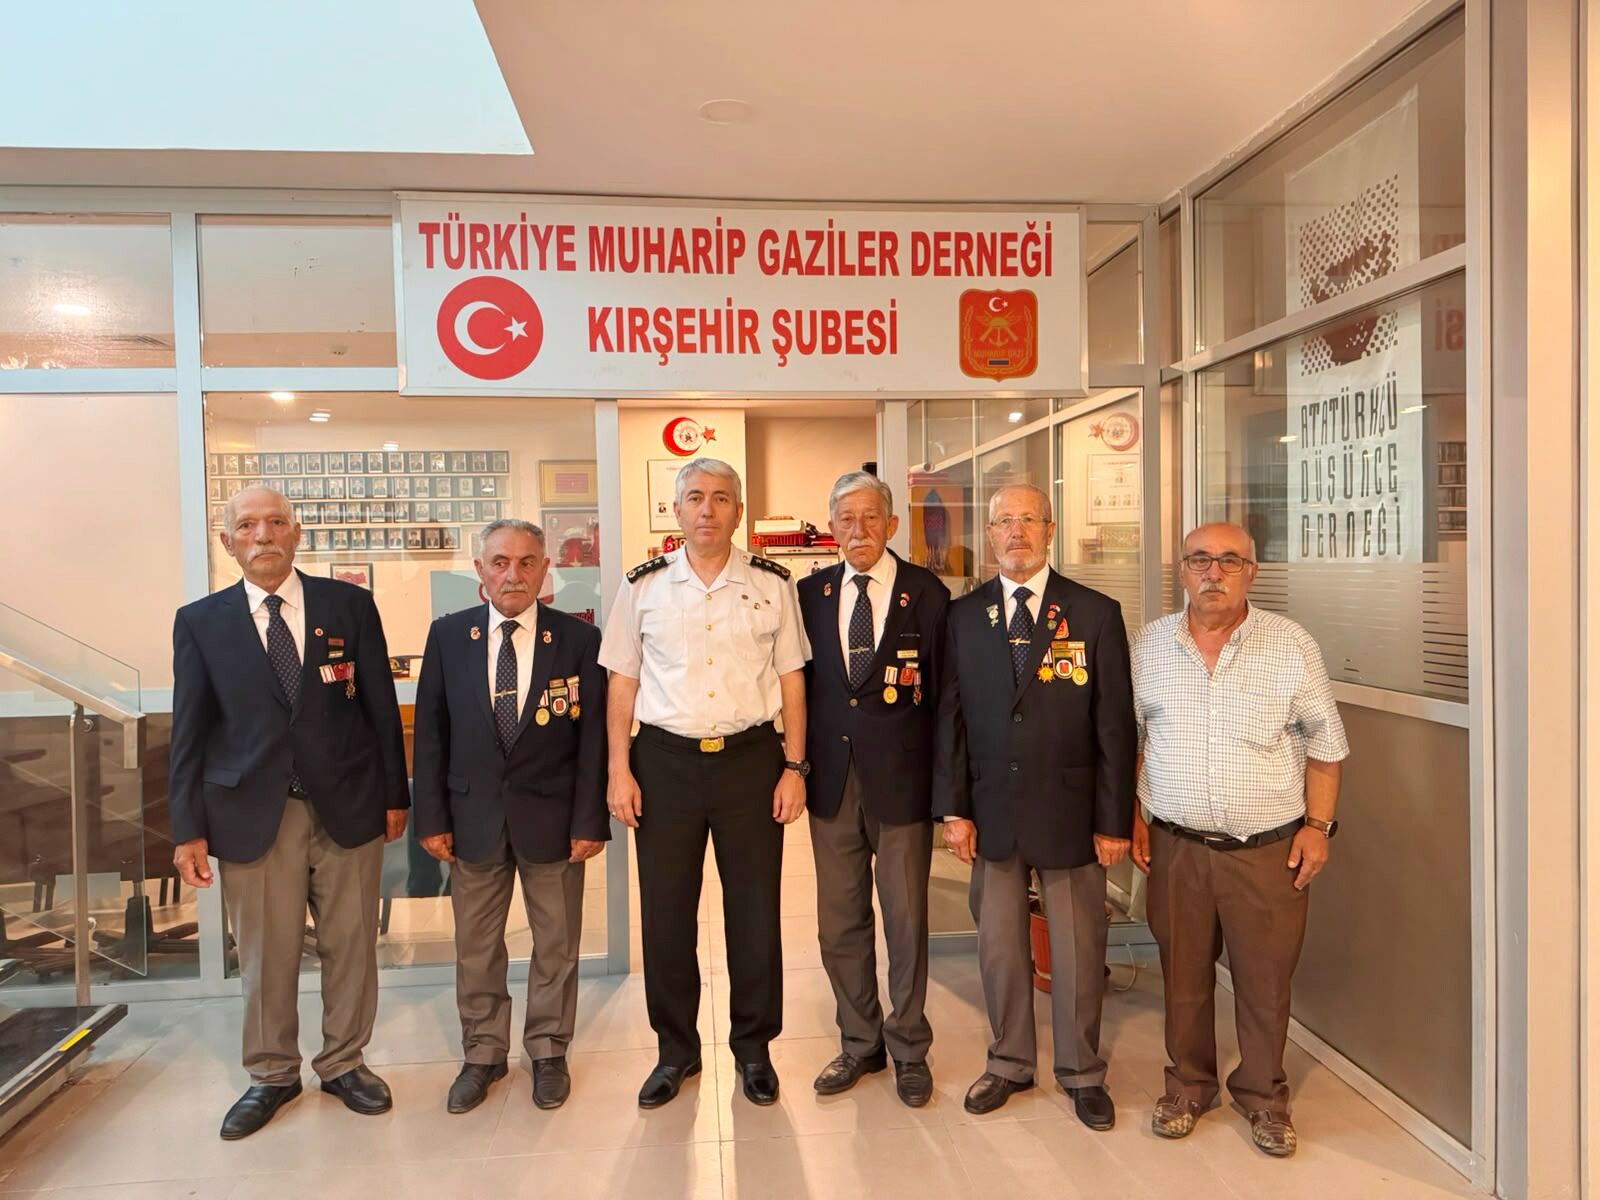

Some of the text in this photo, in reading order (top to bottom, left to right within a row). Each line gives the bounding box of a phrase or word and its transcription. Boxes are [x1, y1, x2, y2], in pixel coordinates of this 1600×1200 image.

[418, 212, 1053, 278] TÜRKİYE MUHARİP GAZİLER DERNEĞİ
[588, 297, 897, 367] KIRŞEHİR ŞUBESİ
[1300, 371, 1398, 449] ATATÜRKÇÜ
[1300, 443, 1398, 505] DÜŞÜNCE
[1300, 496, 1401, 558] DERNEĞİ
